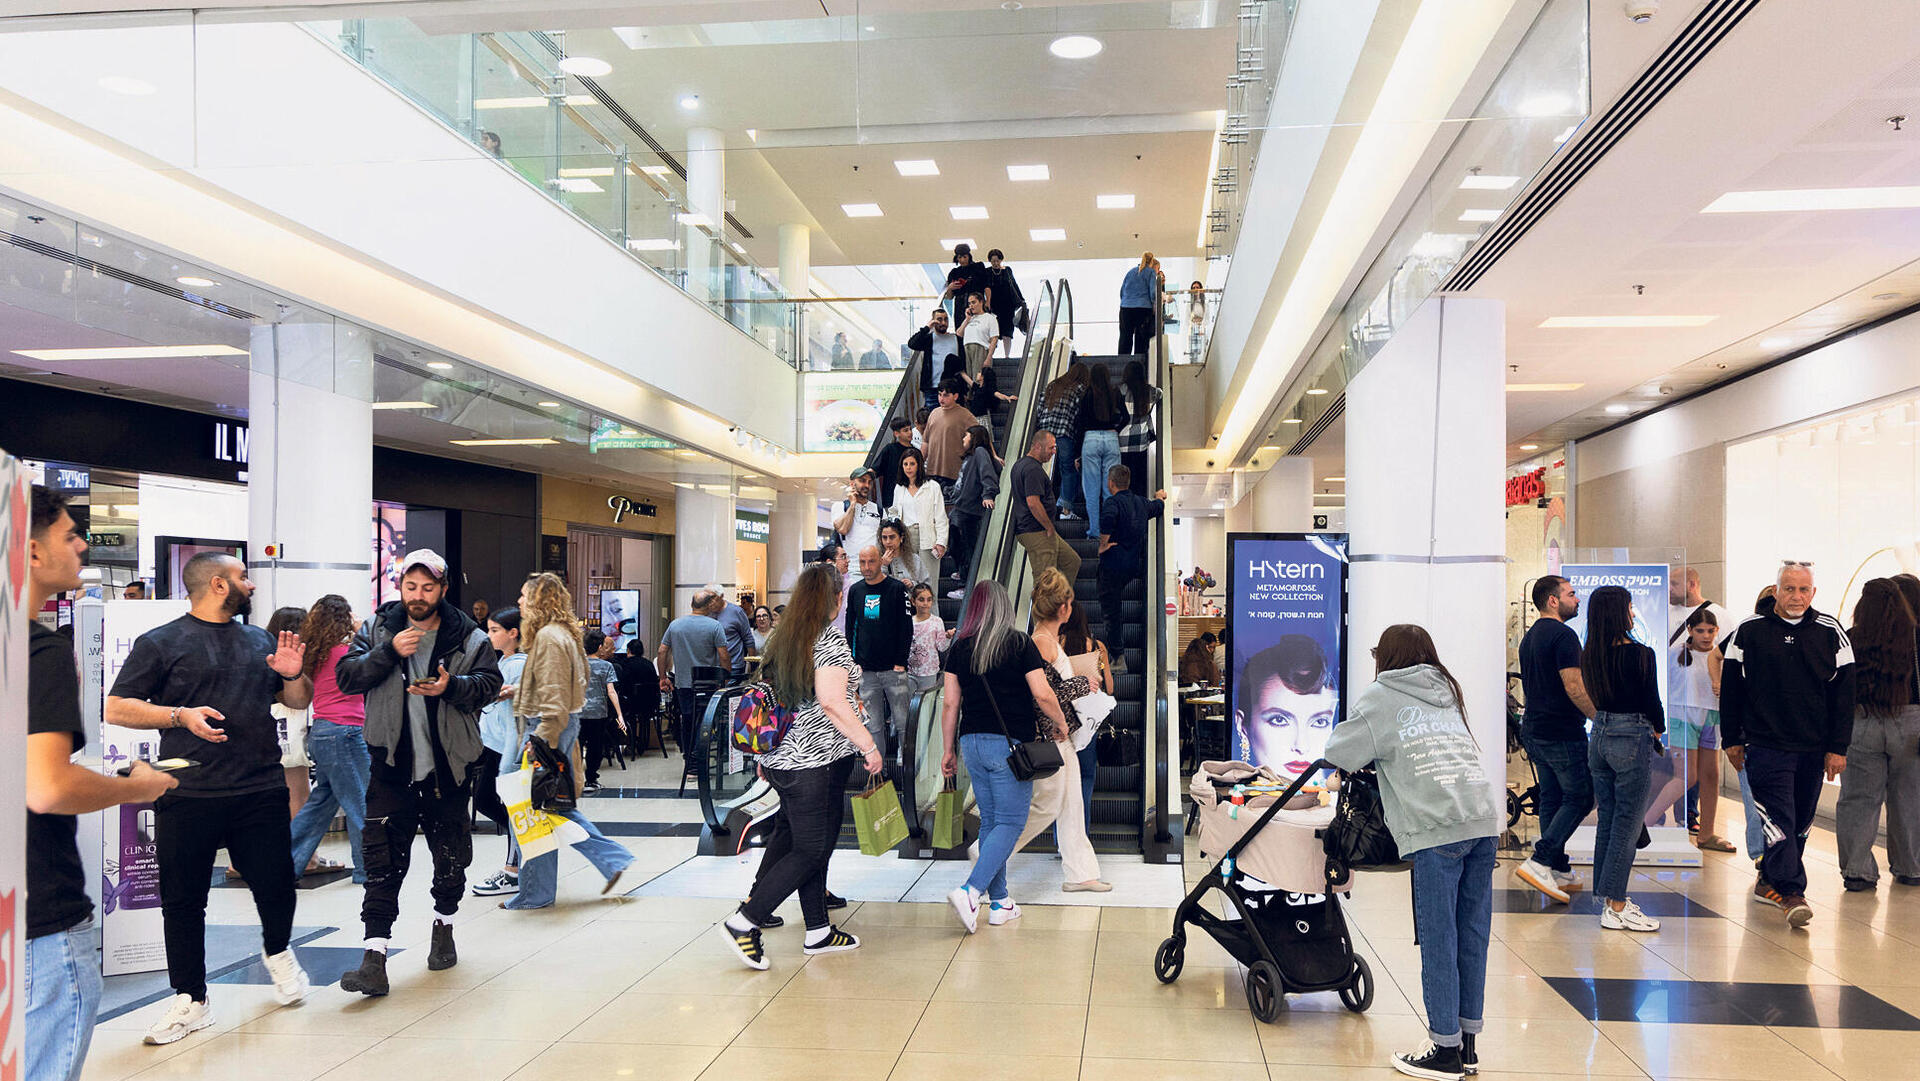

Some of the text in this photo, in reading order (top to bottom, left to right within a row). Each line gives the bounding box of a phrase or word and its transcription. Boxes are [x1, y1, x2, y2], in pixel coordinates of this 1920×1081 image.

[215, 422, 232, 461] IL
[1569, 575, 1662, 588] בוטיק EMBOSS
[1271, 593, 1324, 601] COLLECTION
[1398, 723, 1430, 741] FOR
[124, 844, 157, 855] CLINIQ
